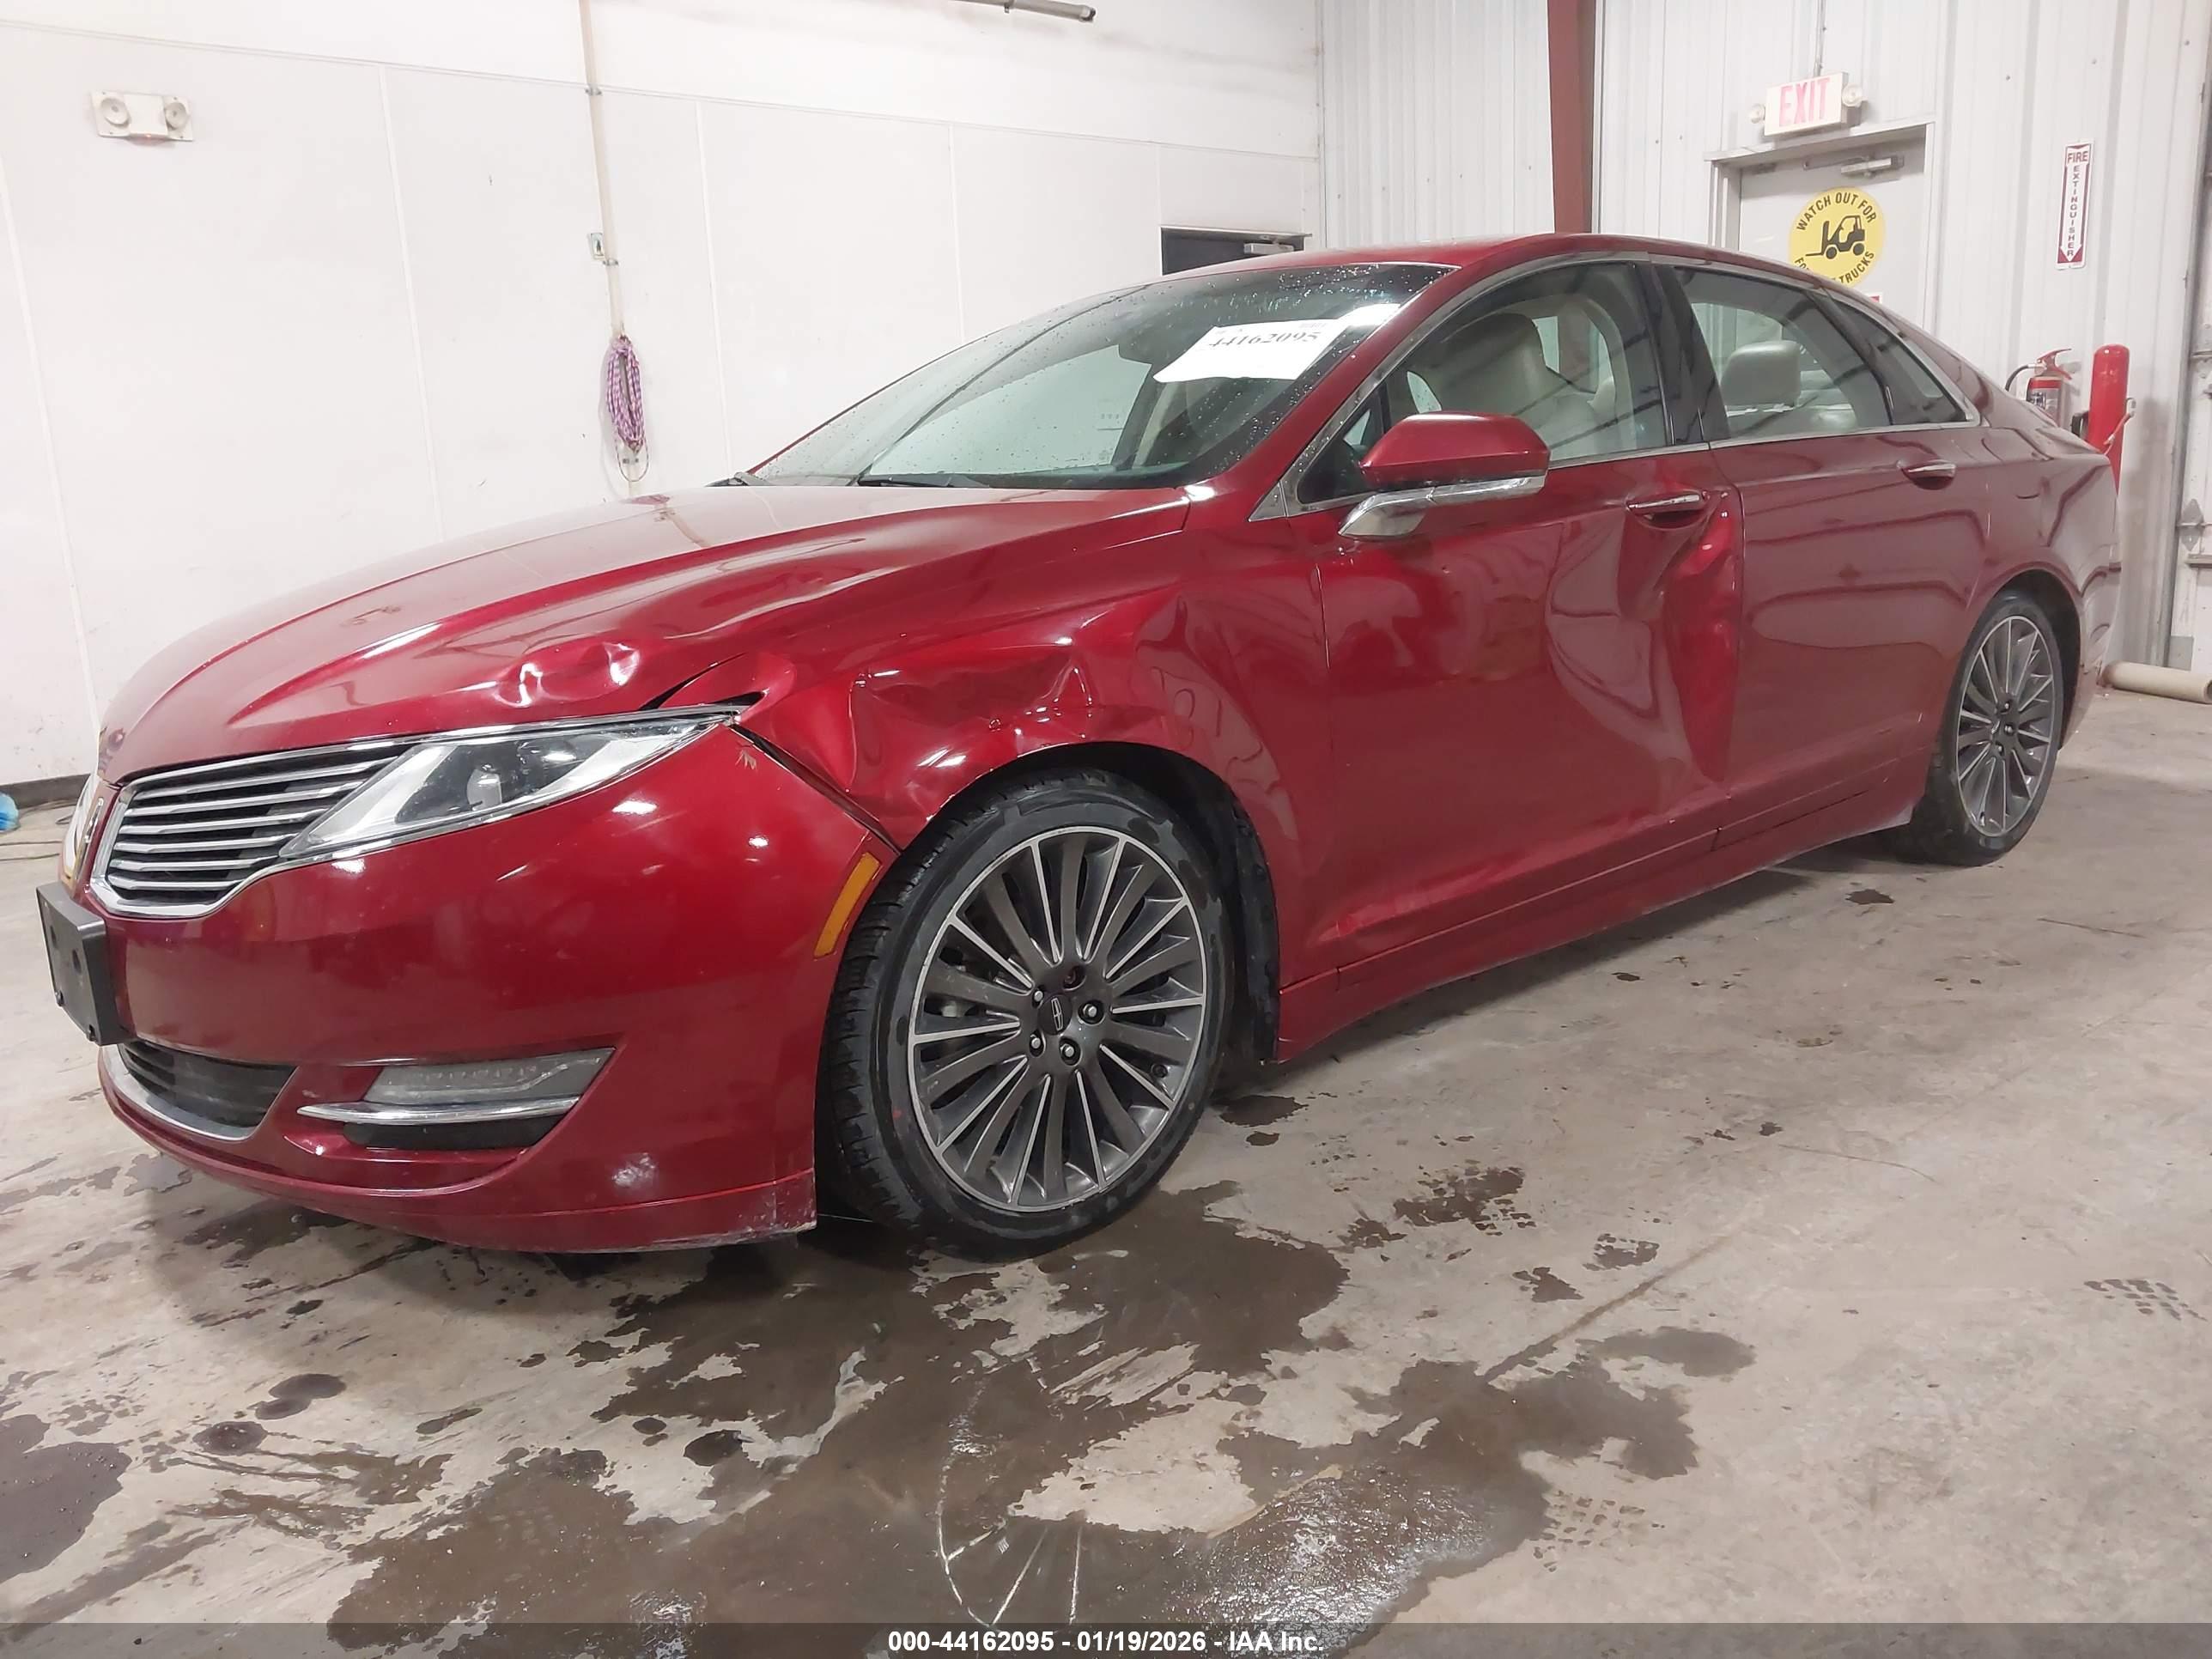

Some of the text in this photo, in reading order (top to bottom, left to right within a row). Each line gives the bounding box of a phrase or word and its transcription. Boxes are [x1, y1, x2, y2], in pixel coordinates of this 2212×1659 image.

[1778, 77, 1831, 127] EXIT
[2067, 150, 2089, 164] FIRE
[1796, 191, 1877, 231] WATCH OUT FOR
[2066, 165, 2081, 257] EXTINGUISHER
[1838, 251, 1875, 283] TRUCKS
[1209, 332, 1321, 347] 44162095
